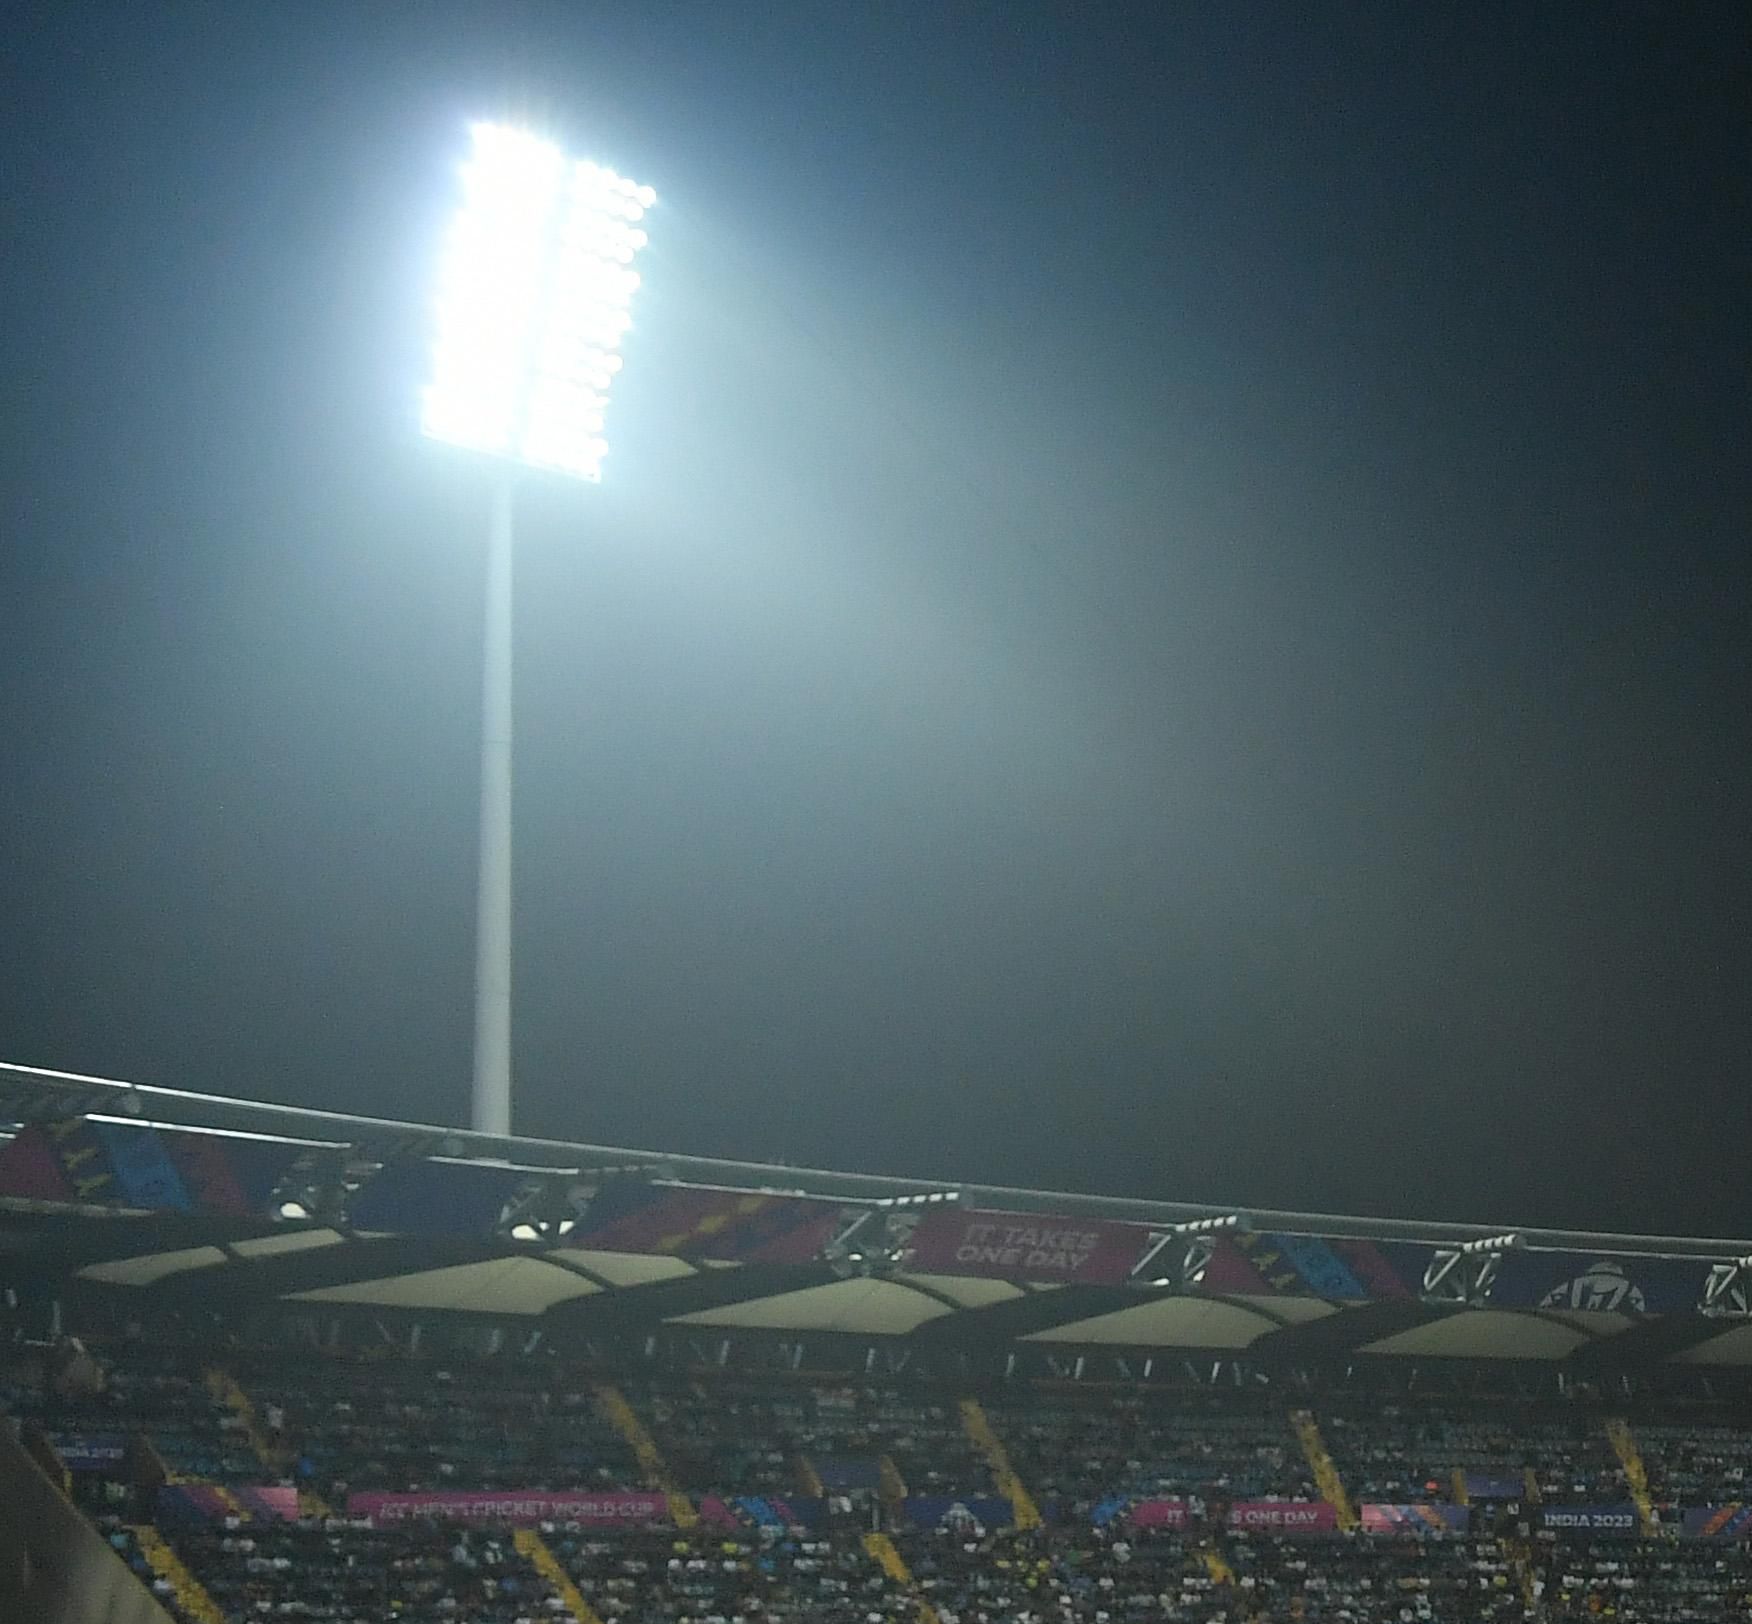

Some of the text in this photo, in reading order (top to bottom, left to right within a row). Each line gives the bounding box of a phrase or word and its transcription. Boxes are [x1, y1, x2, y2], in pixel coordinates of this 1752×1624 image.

[967, 1224, 1099, 1249] IT TAKES
[956, 1246, 1088, 1270] ONE DAY
[1246, 1510, 1282, 1525] ONE
[1285, 1510, 1318, 1525] DAY
[1544, 1513, 1633, 1527] INDIA 2023
